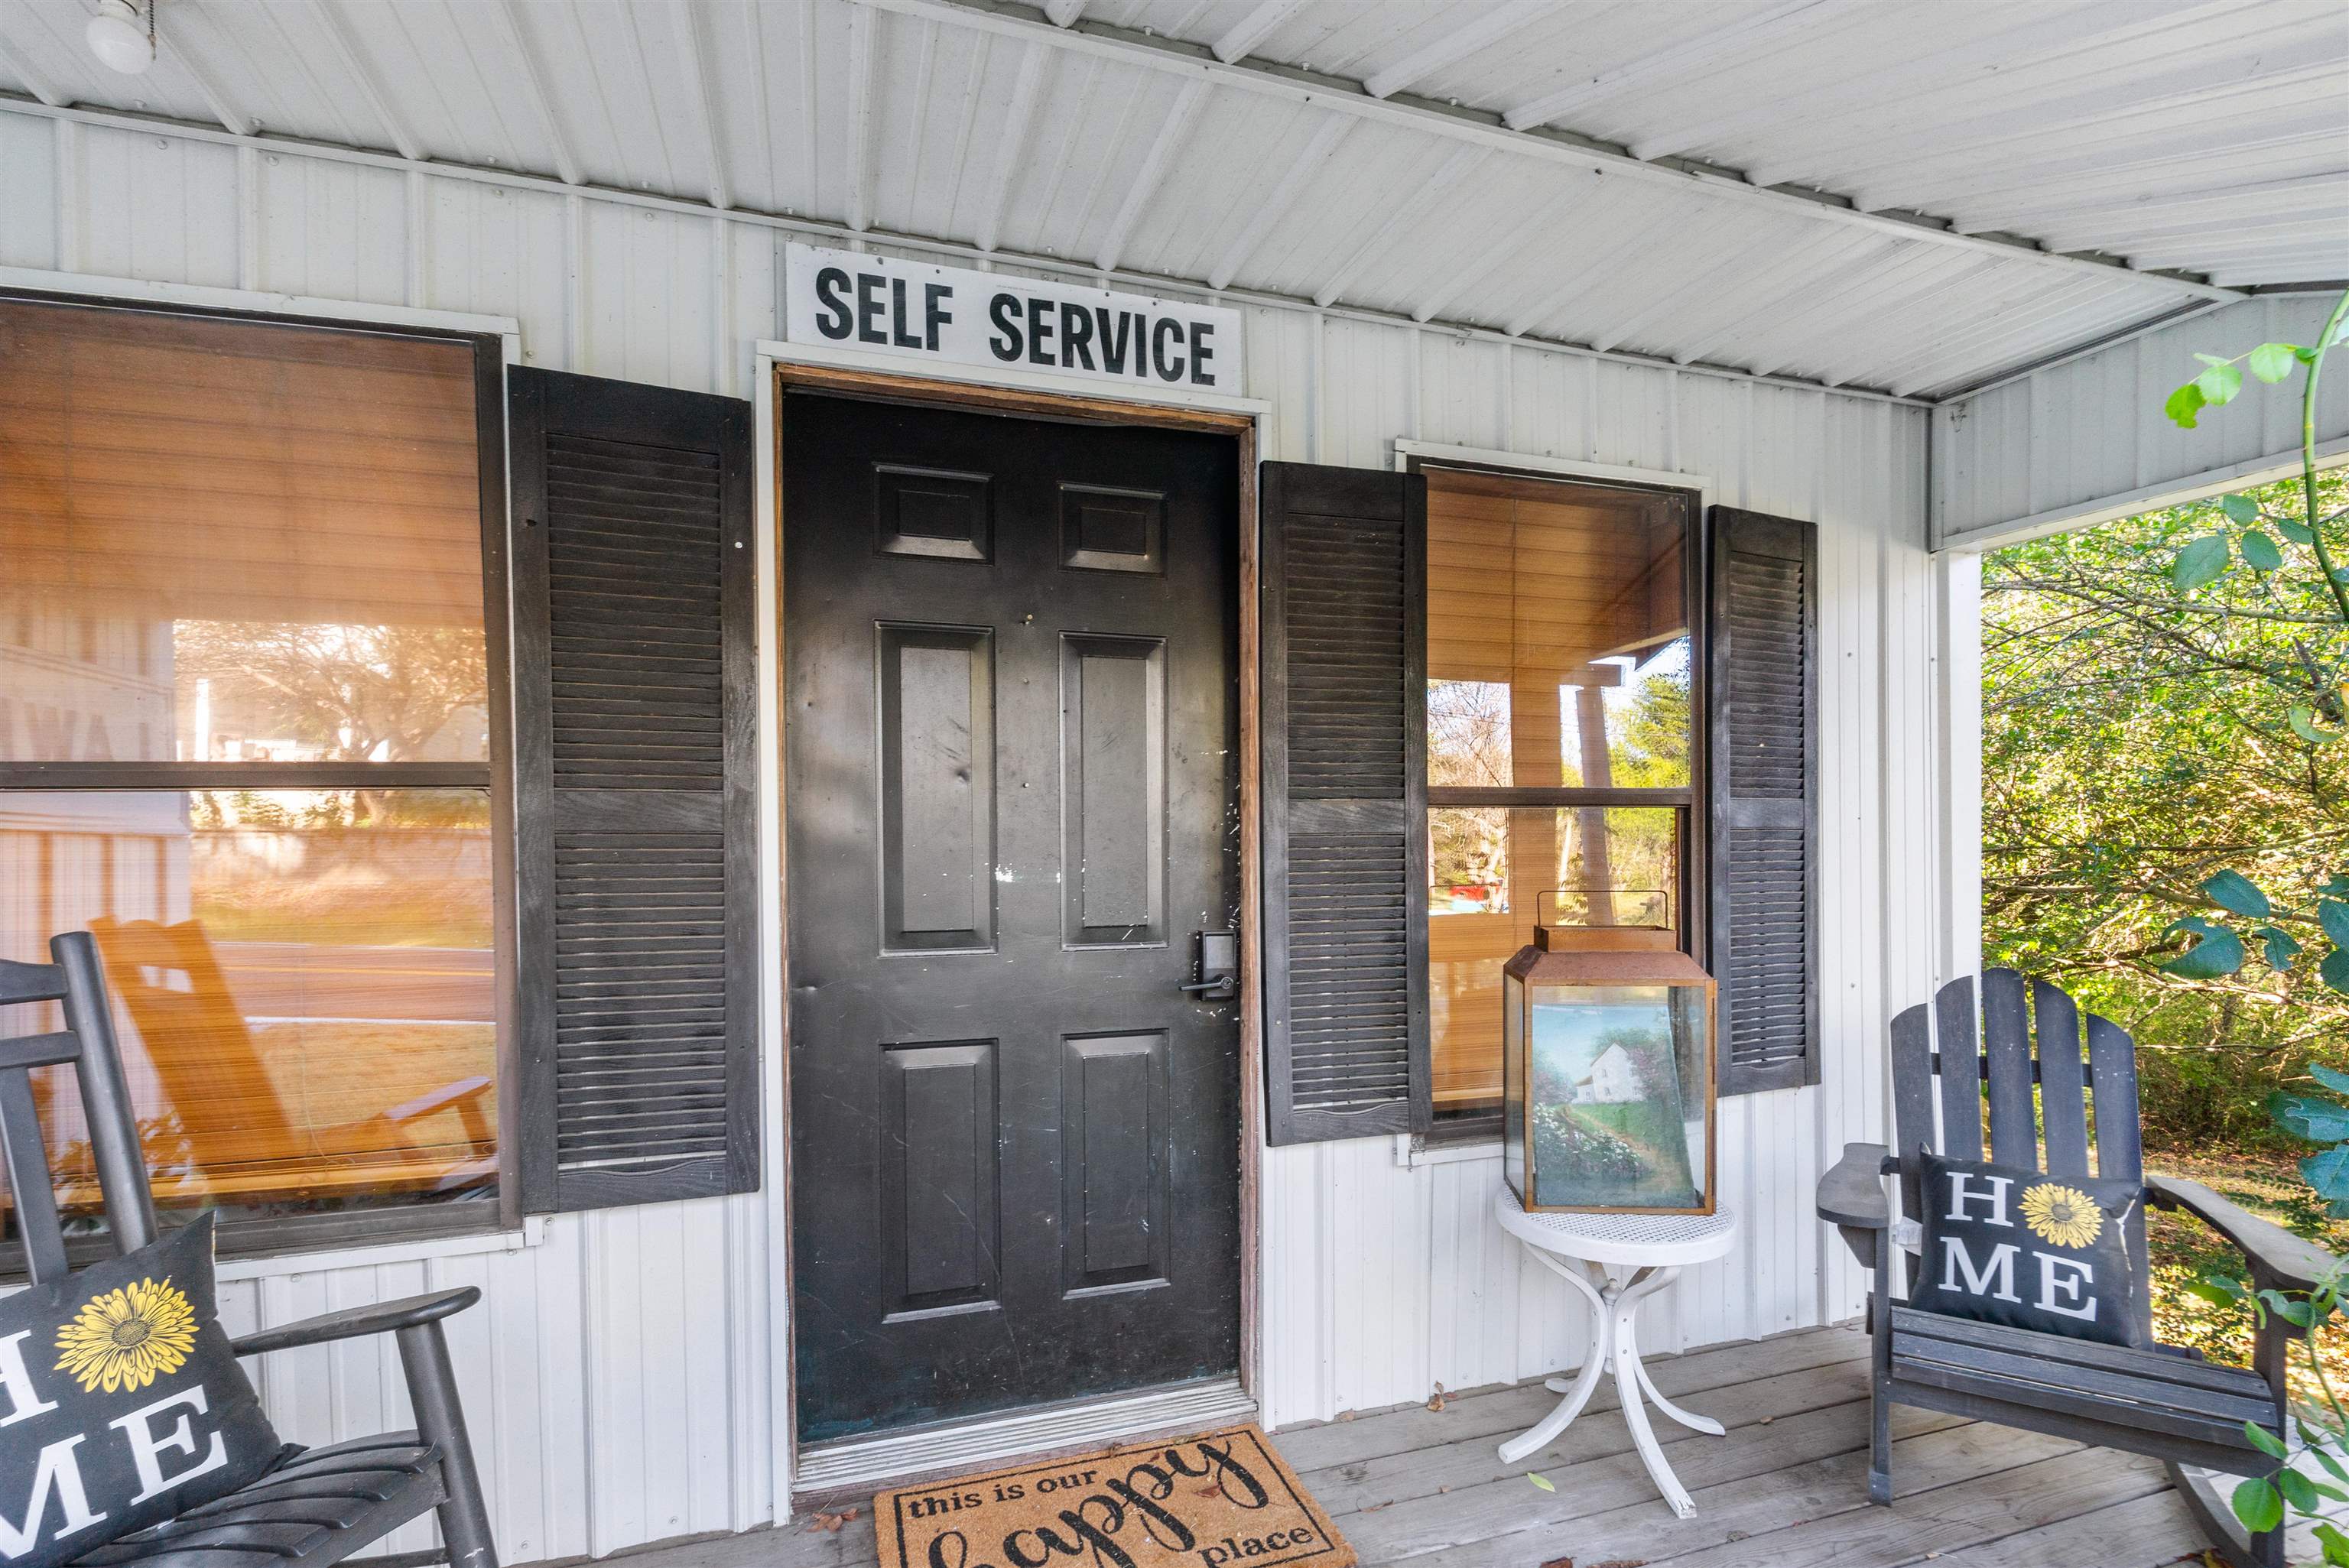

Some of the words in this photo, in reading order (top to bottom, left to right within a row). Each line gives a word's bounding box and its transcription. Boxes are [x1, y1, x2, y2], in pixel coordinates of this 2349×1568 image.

[816, 267, 953, 352] SELF
[989, 293, 1216, 386] SERVICE
[1945, 1171, 2014, 1227] H
[1938, 1236, 2097, 1322] ME
[0, 1385, 229, 1560] ME
[908, 1492, 983, 1518] this
[995, 1483, 1025, 1502] is
[1036, 1470, 1098, 1494] our
[1197, 1527, 1314, 1568] place
